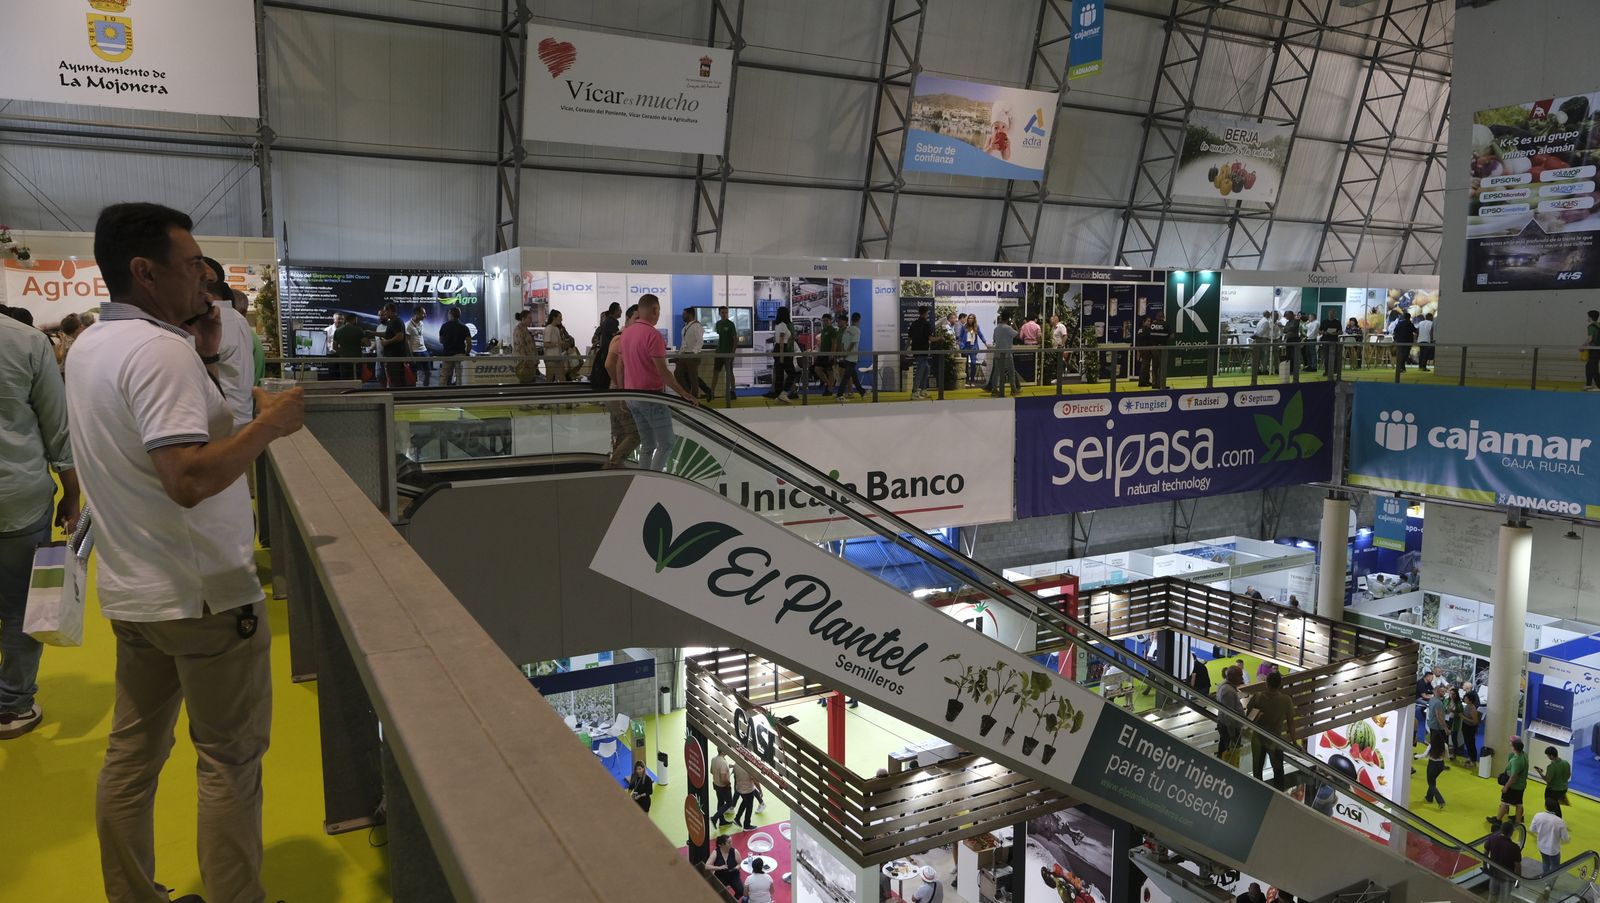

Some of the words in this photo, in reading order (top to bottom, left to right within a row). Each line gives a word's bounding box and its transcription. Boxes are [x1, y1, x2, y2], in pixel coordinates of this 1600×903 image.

[1074, 26, 1100, 40] cajamar
[58, 60, 150, 79] Ayuntamiento
[152, 69, 166, 79] de
[59, 73, 82, 88] La
[86, 76, 169, 95] Mojonera
[565, 79, 624, 105] Vícar
[635, 92, 699, 112] mucho
[1022, 136, 1042, 147] adra
[1500, 136, 1520, 148] K+S
[1520, 136, 1532, 144] es
[1533, 134, 1546, 143] un
[1547, 130, 1579, 143] grupo
[916, 142, 943, 153] Sabor
[944, 144, 956, 155] de
[1502, 148, 1536, 161] minero
[1537, 142, 1575, 155] alemán
[914, 153, 954, 164] confianza
[384, 275, 479, 293] BIHOX
[1308, 274, 1338, 286] Koppert
[1557, 272, 1583, 280] K+S
[552, 282, 592, 292] Dinox
[630, 286, 667, 294] Dinox
[453, 293, 478, 306] Agro
[1175, 283, 1211, 334] K
[1134, 400, 1168, 412] Fungisei
[1194, 396, 1220, 407] Radisei
[1248, 394, 1274, 405] Septum
[1072, 403, 1104, 416] Pirecris
[1427, 419, 1592, 462] cajamar
[1501, 457, 1535, 470] CAJA
[1539, 461, 1584, 476] RURAL
[866, 469, 965, 501] Banco
[1127, 480, 1160, 496] natural
[1161, 476, 1211, 492] technology
[1507, 494, 1582, 515] ADNAGRO
[1377, 514, 1404, 523] cajamar
[707, 546, 781, 606] El
[774, 573, 929, 677] Plantel
[835, 654, 904, 696] Semilleros
[734, 708, 776, 770] CASI
[1117, 723, 1138, 748] El
[1136, 737, 1185, 773] mejor
[1186, 758, 1234, 800] injerto
[1104, 753, 1146, 784] para
[1148, 769, 1166, 793] tu
[1166, 783, 1228, 825] cosecha
[1336, 803, 1362, 823] CASI
